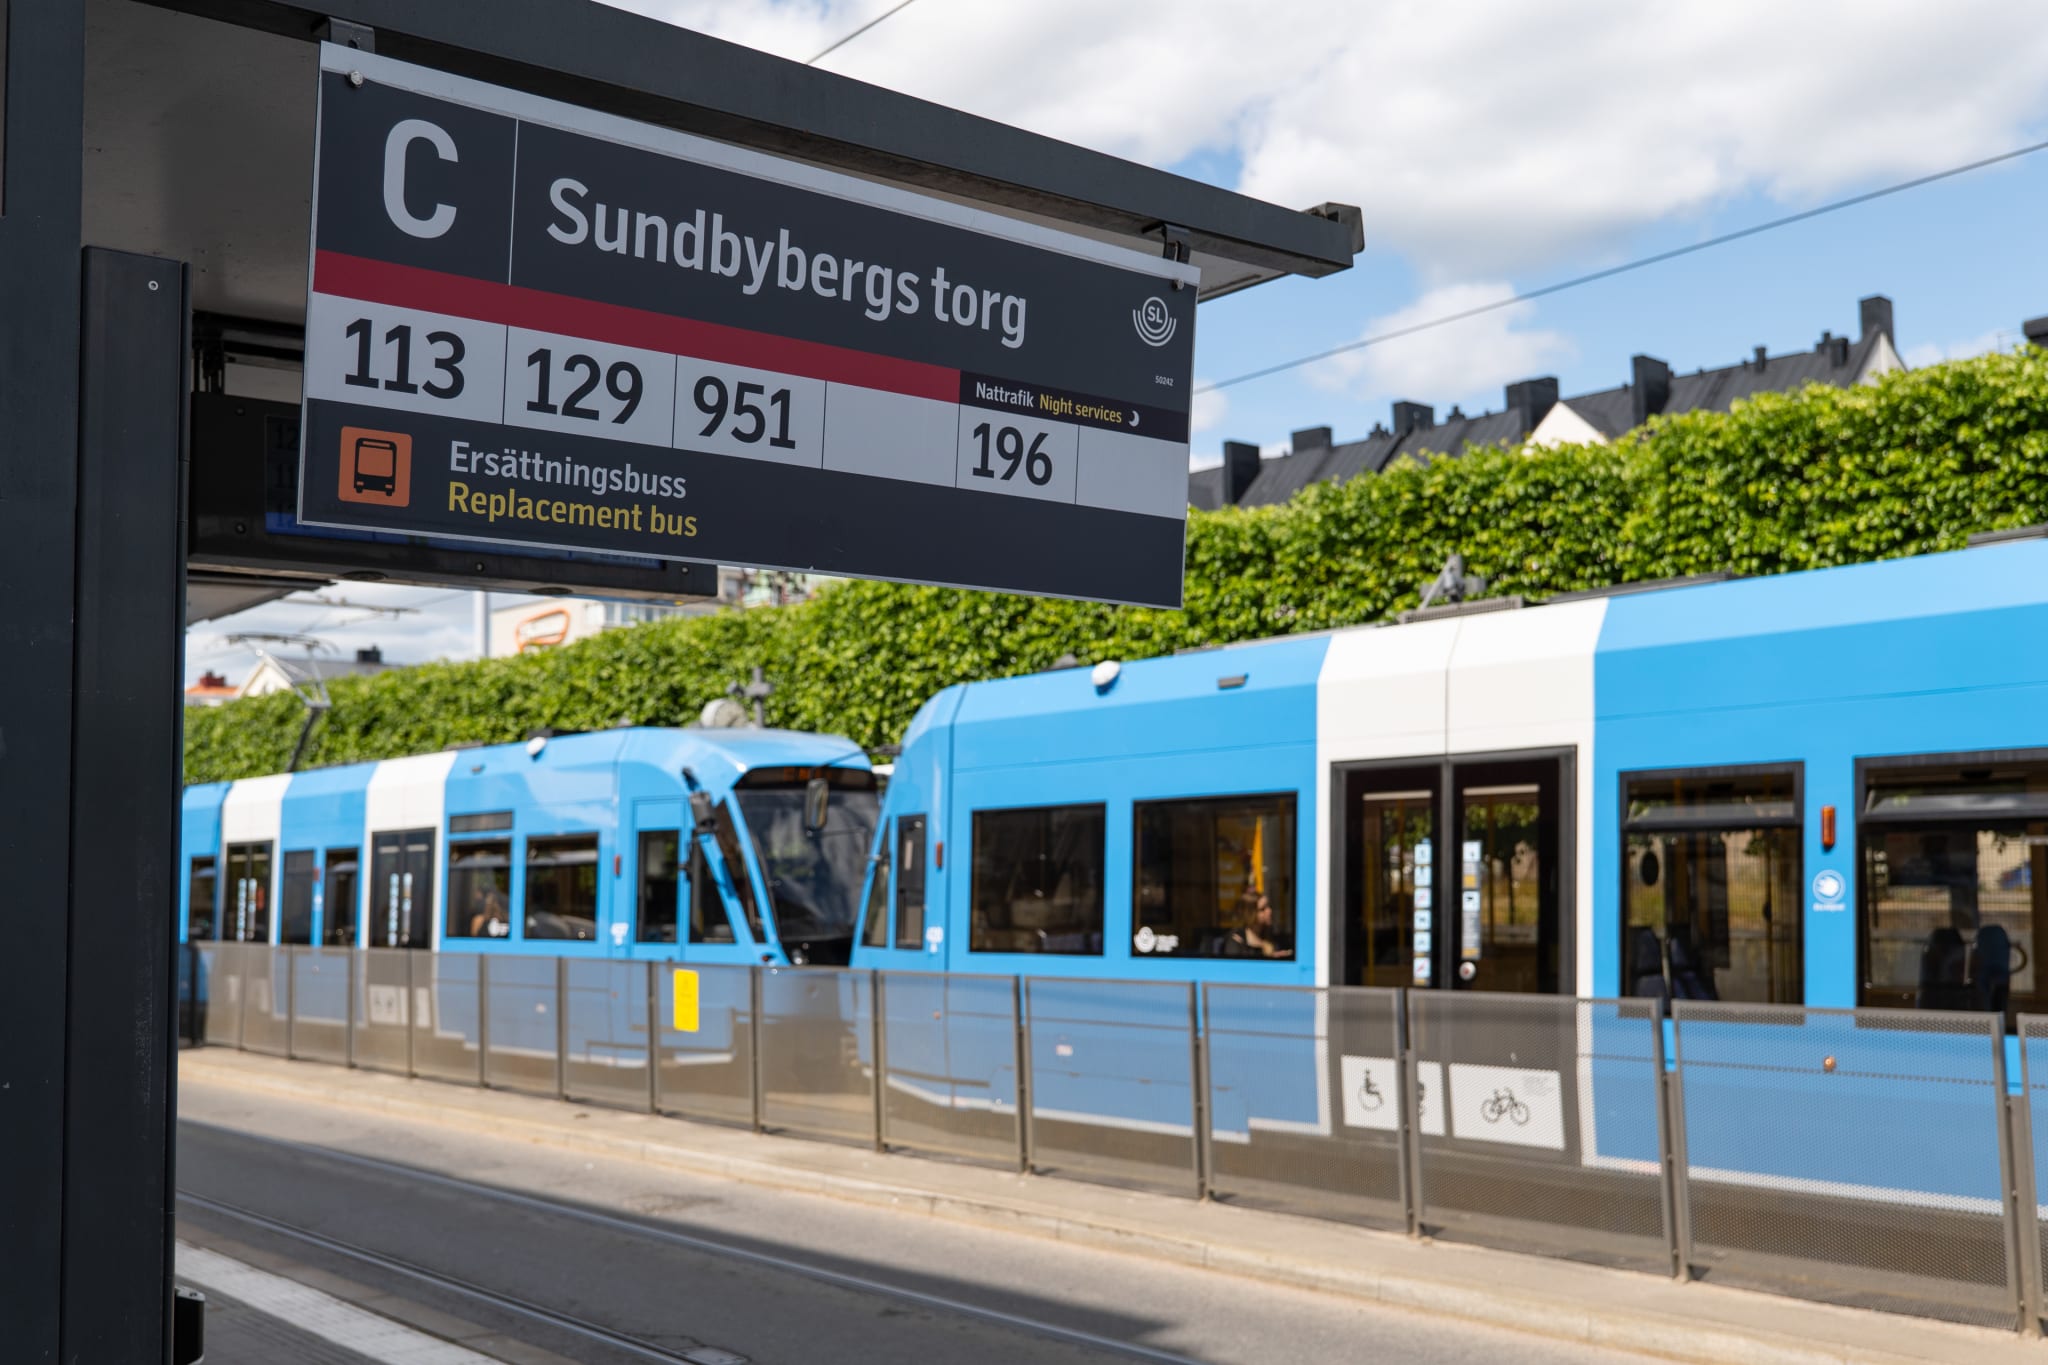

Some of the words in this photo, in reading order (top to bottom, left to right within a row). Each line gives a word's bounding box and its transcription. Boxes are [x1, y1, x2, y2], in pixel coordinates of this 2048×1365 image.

[383, 119, 460, 239] C
[546, 178, 920, 322] Sundbybergs
[930, 266, 1027, 349] torg
[1147, 306, 1163, 323] SL
[345, 319, 466, 400] 113
[526, 348, 644, 424] 129
[1155, 375, 1174, 387] 50242
[693, 375, 796, 450] 951
[975, 381, 1034, 408] Nattrafik
[1039, 393, 1073, 416] Night
[1075, 405, 1122, 424] services
[449, 440, 687, 499] Ersättningsbuss
[972, 422, 1054, 486] 196
[448, 481, 643, 532] Replacement
[650, 504, 698, 537] bus
